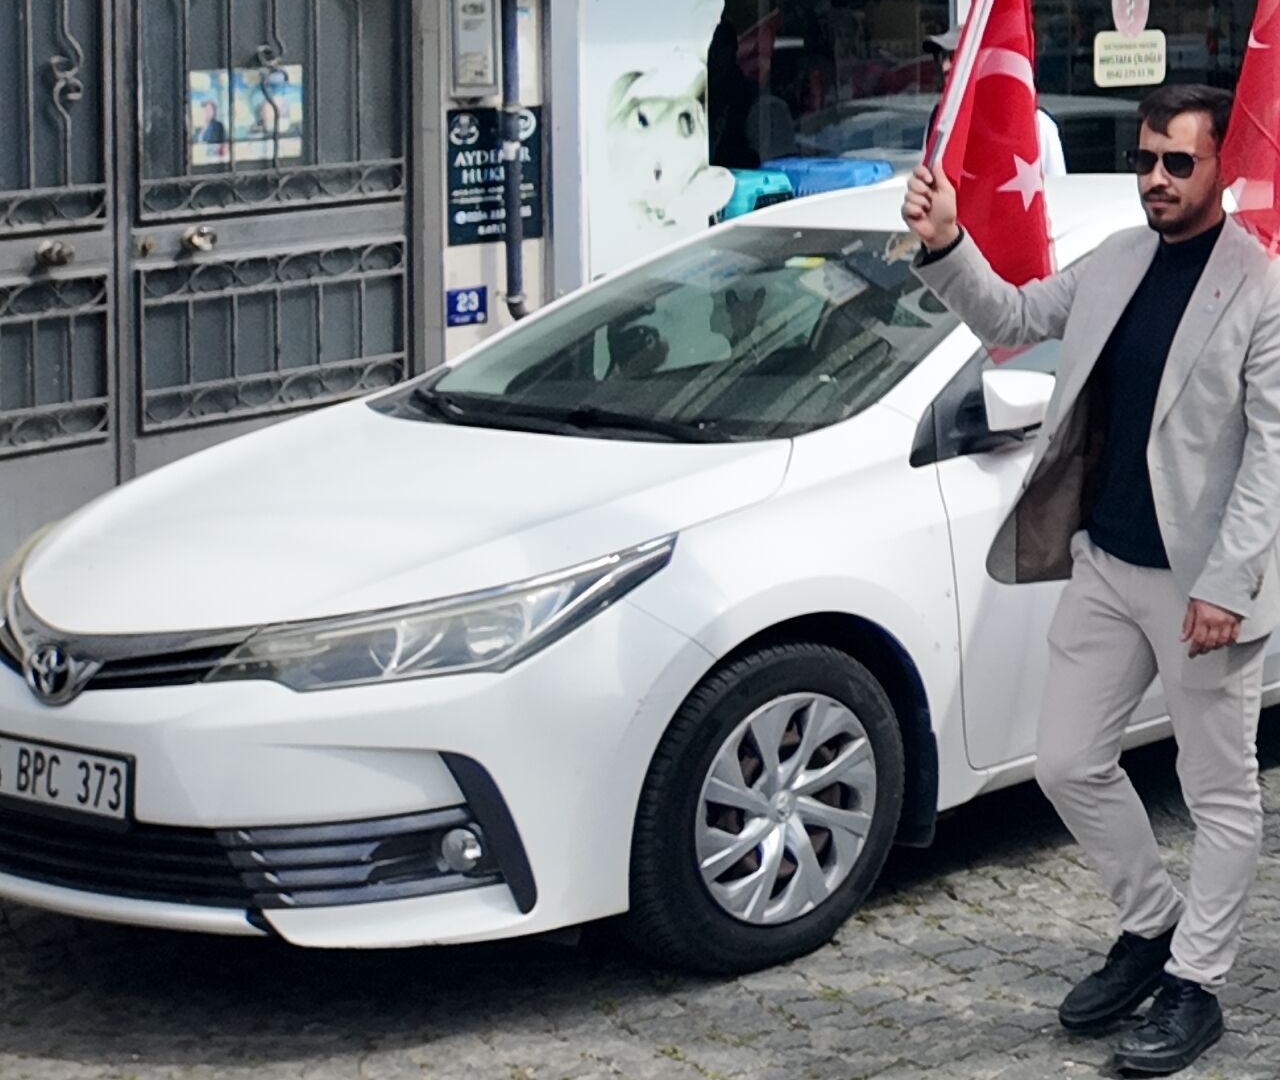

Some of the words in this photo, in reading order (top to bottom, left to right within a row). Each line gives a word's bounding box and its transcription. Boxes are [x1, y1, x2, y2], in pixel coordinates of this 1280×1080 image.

[456, 292, 479, 313] 23
[16, 748, 60, 798] BPC
[77, 761, 122, 811] 373
